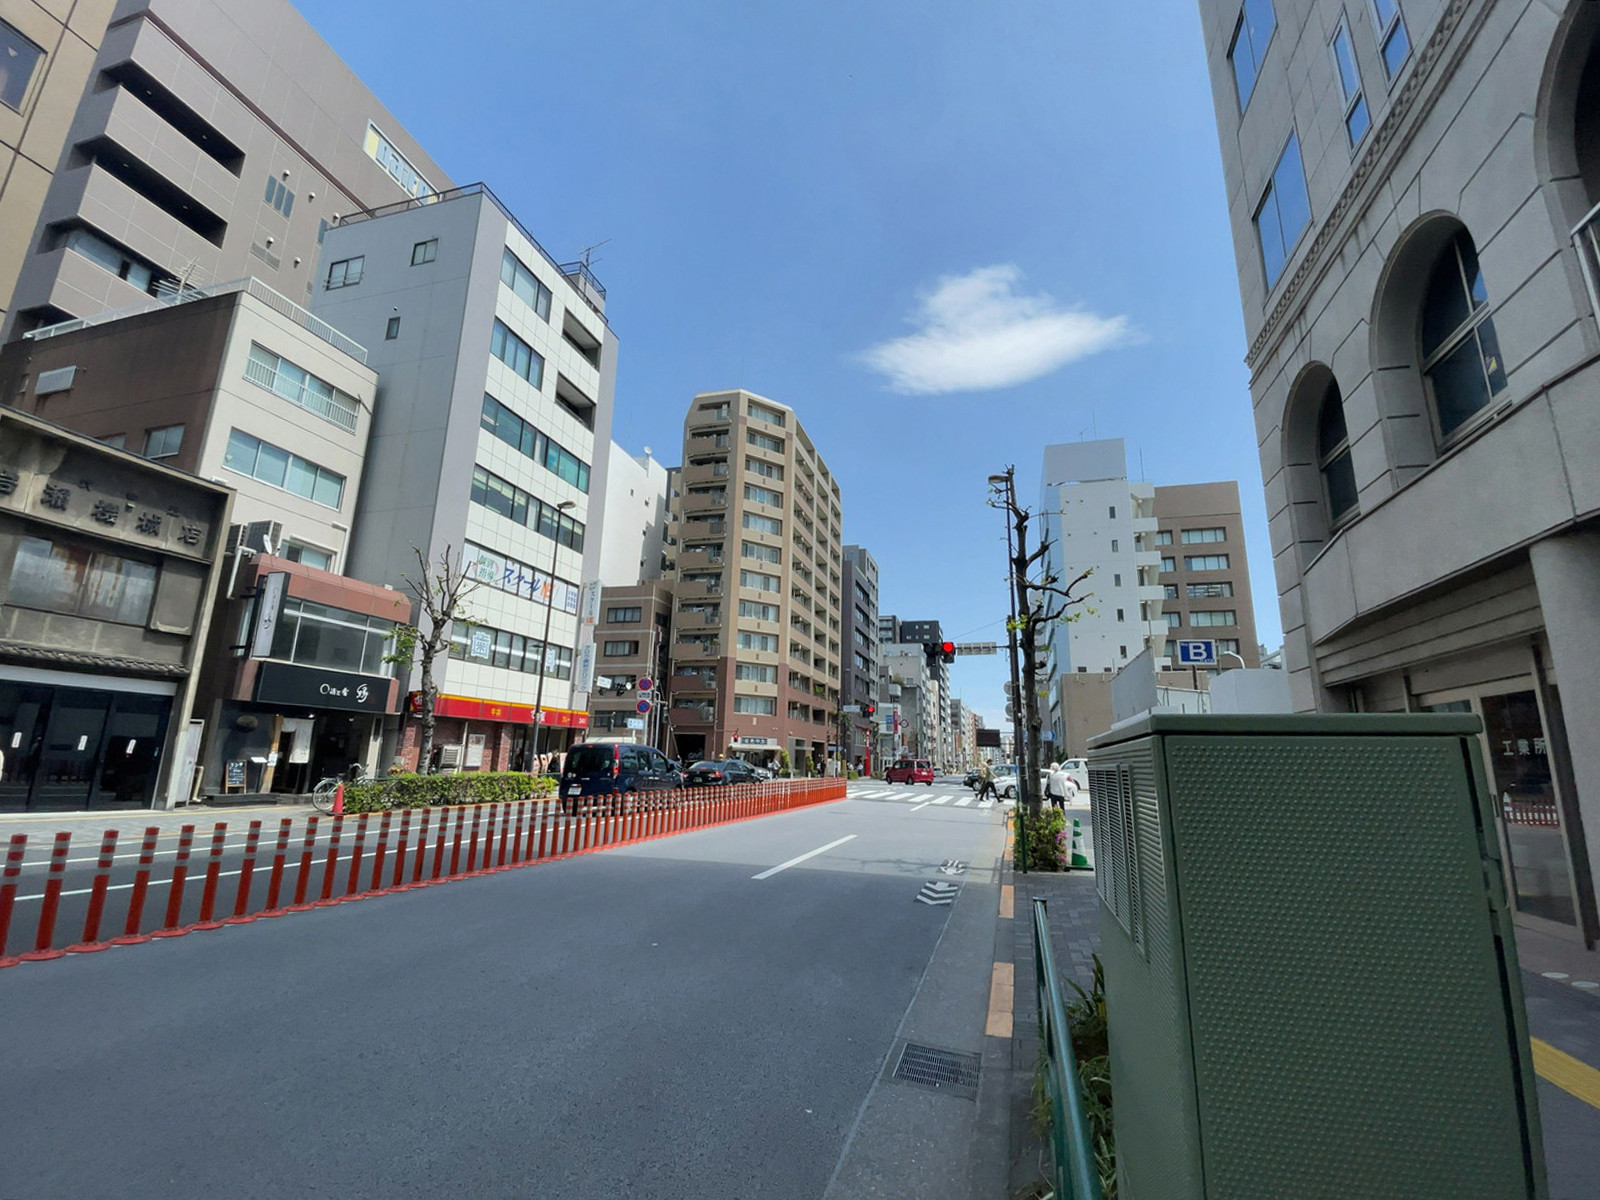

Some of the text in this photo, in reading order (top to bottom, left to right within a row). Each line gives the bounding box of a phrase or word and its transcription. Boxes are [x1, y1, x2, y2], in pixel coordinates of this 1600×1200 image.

[470, 631, 491, 660] 歯
[1189, 643, 1207, 660] B
[1502, 738, 1547, 756] 工業所
